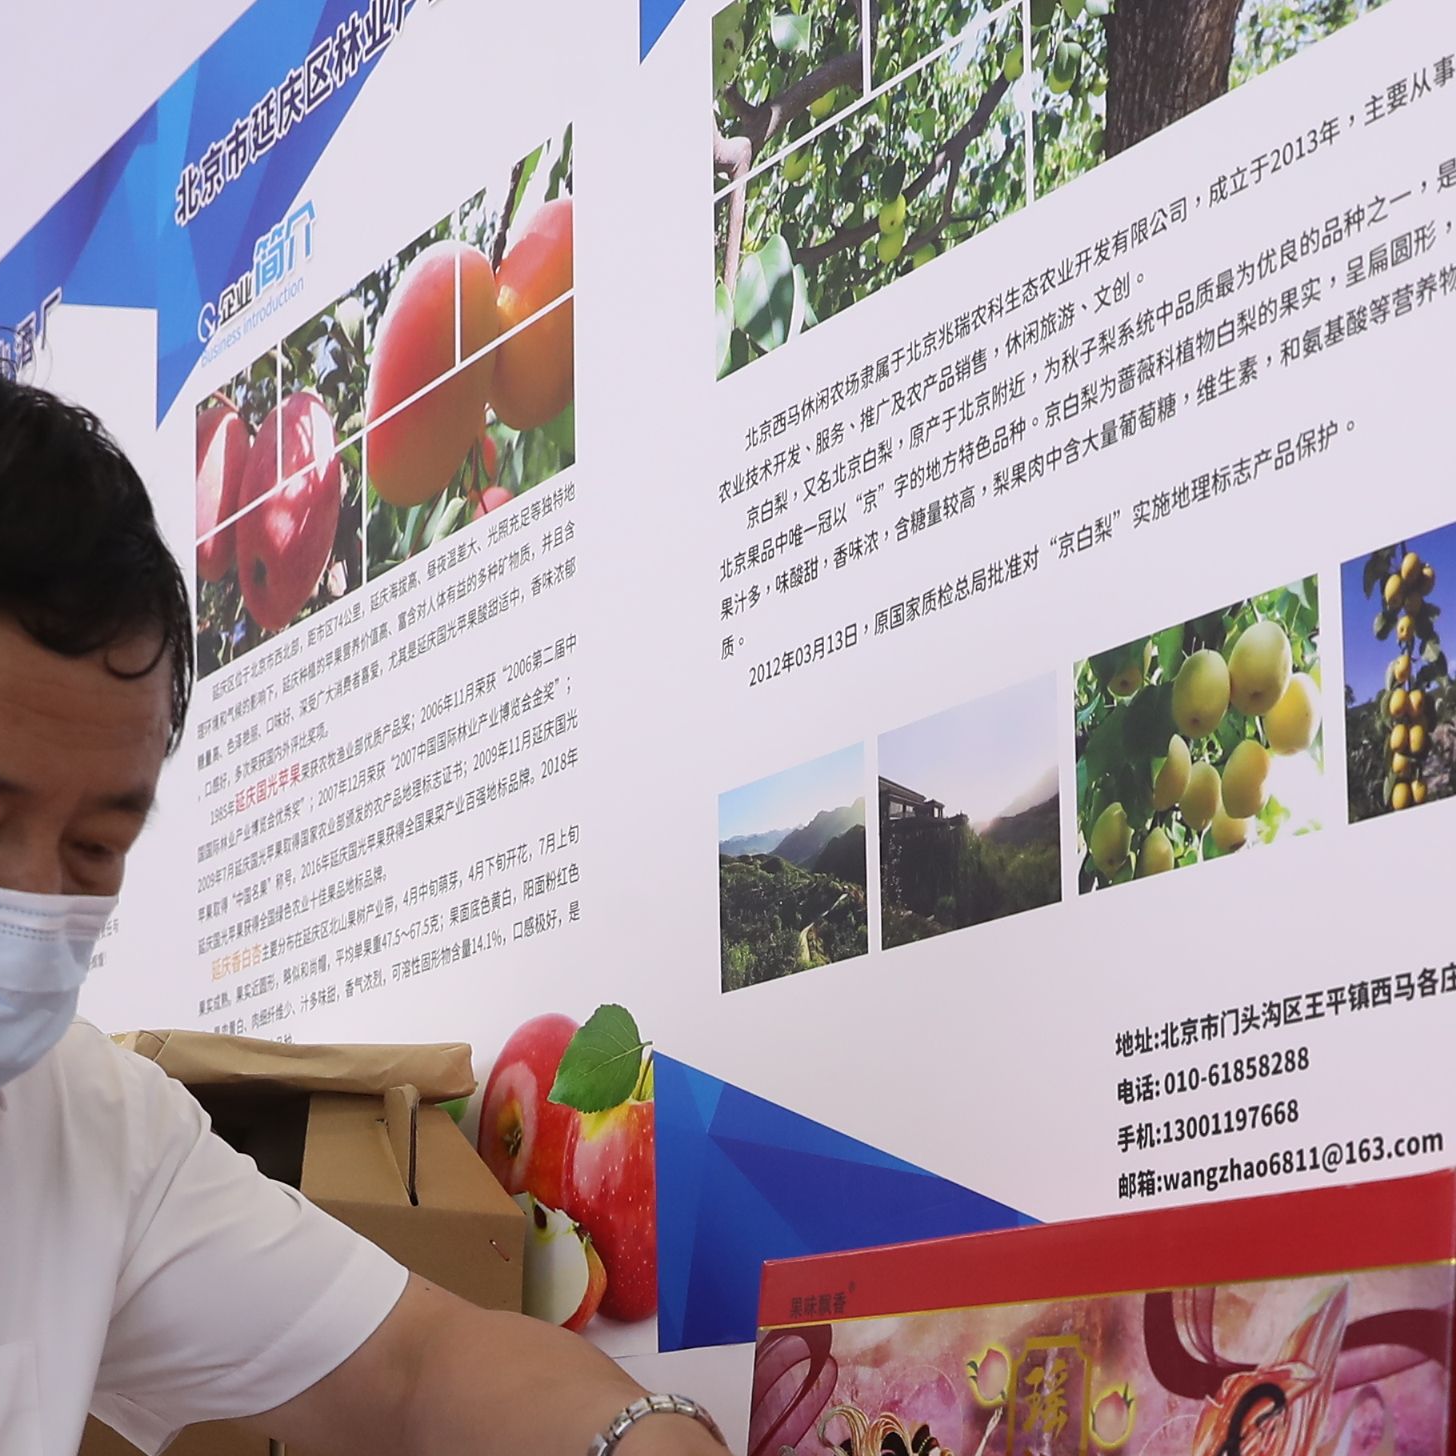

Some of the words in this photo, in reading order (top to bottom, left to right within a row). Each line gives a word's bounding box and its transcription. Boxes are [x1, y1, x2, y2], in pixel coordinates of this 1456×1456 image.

[176, 0, 408, 226] 北京市延庆区林业
